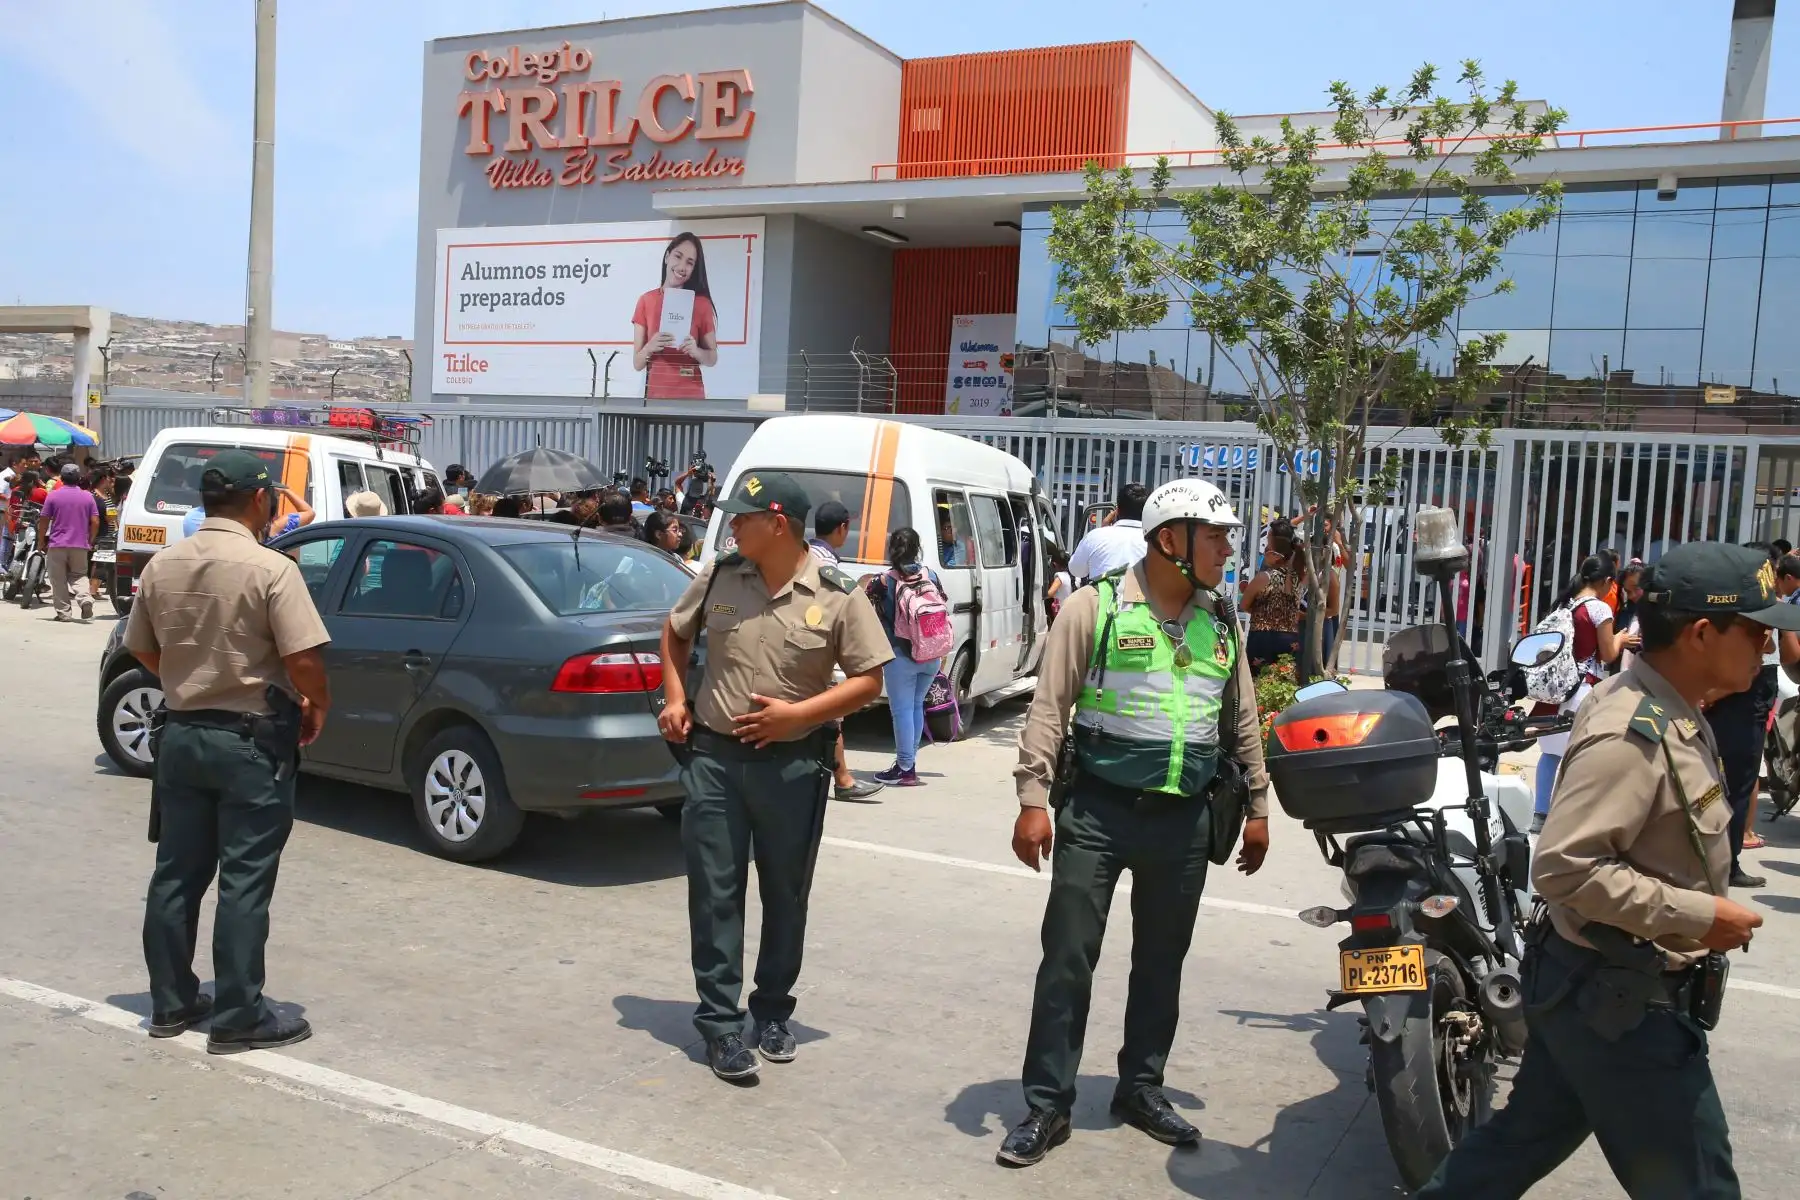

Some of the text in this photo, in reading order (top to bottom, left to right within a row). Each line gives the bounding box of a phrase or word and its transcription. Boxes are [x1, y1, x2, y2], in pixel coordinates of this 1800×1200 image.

[464, 40, 592, 83] Colegio
[458, 69, 755, 155] TRILCE
[485, 147, 745, 190] Villa El Salvador
[460, 258, 611, 284] Alumnos mejor
[459, 287, 565, 312] preparados
[443, 352, 489, 372] Trilce
[953, 376, 1007, 388] SCHOOL
[969, 398, 990, 407] 2019
[1152, 486, 1200, 509] TRANSITO
[125, 526, 164, 542] ASG-277
[1706, 594, 1738, 603] PERU
[1367, 953, 1392, 964] PNP
[1349, 963, 1418, 987] PL-23716
